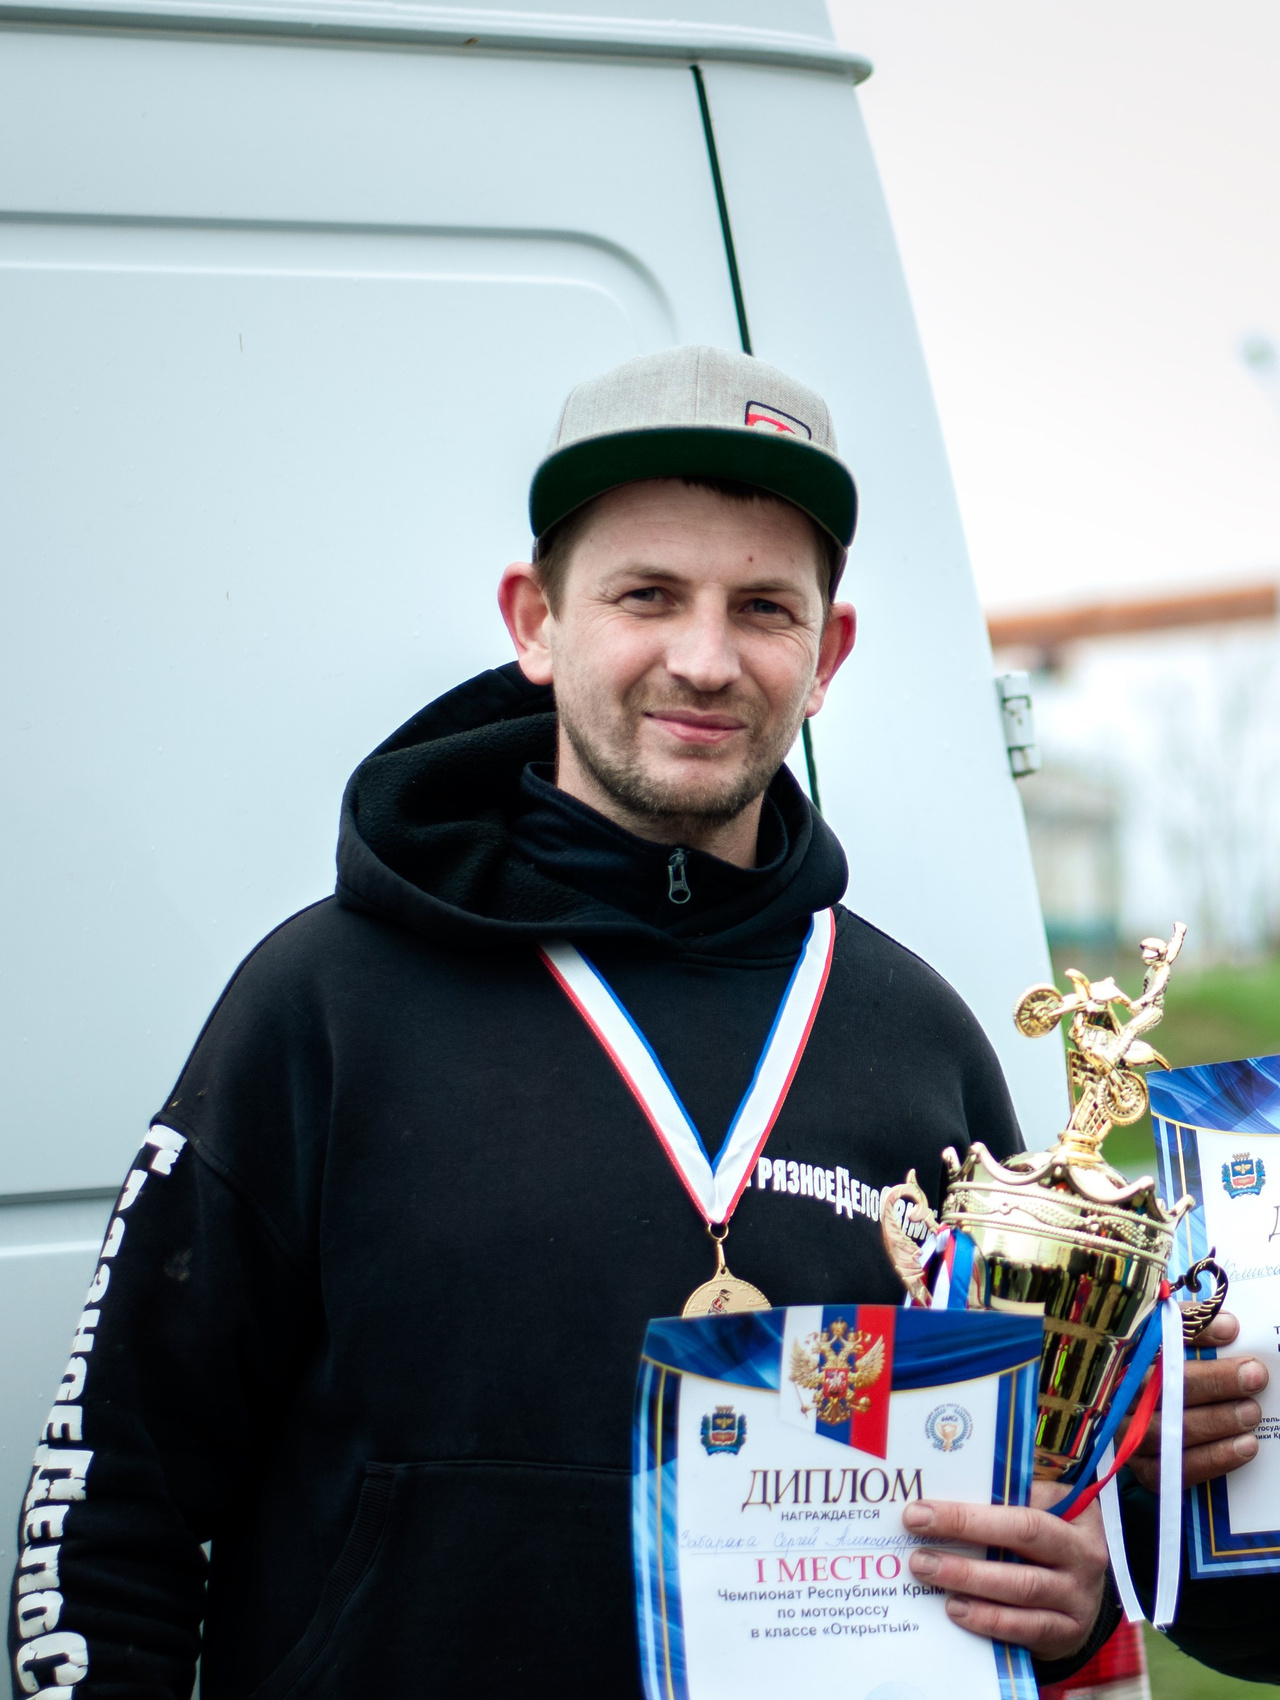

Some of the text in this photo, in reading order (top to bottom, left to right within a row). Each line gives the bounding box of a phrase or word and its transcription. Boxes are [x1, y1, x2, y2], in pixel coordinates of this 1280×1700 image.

[741, 1467, 924, 1512] ДИПЛОМ
[781, 1509, 880, 1521] НАГРАЖДАЕТСЯ
[773, 1526, 820, 1557] Сергей
[776, 1554, 902, 1583] МЕСТО
[717, 1582, 945, 1602] Чемпионат Республики Крым
[777, 1603, 889, 1620] по мотокроссу
[751, 1620, 920, 1638] в классе «Открытый»
